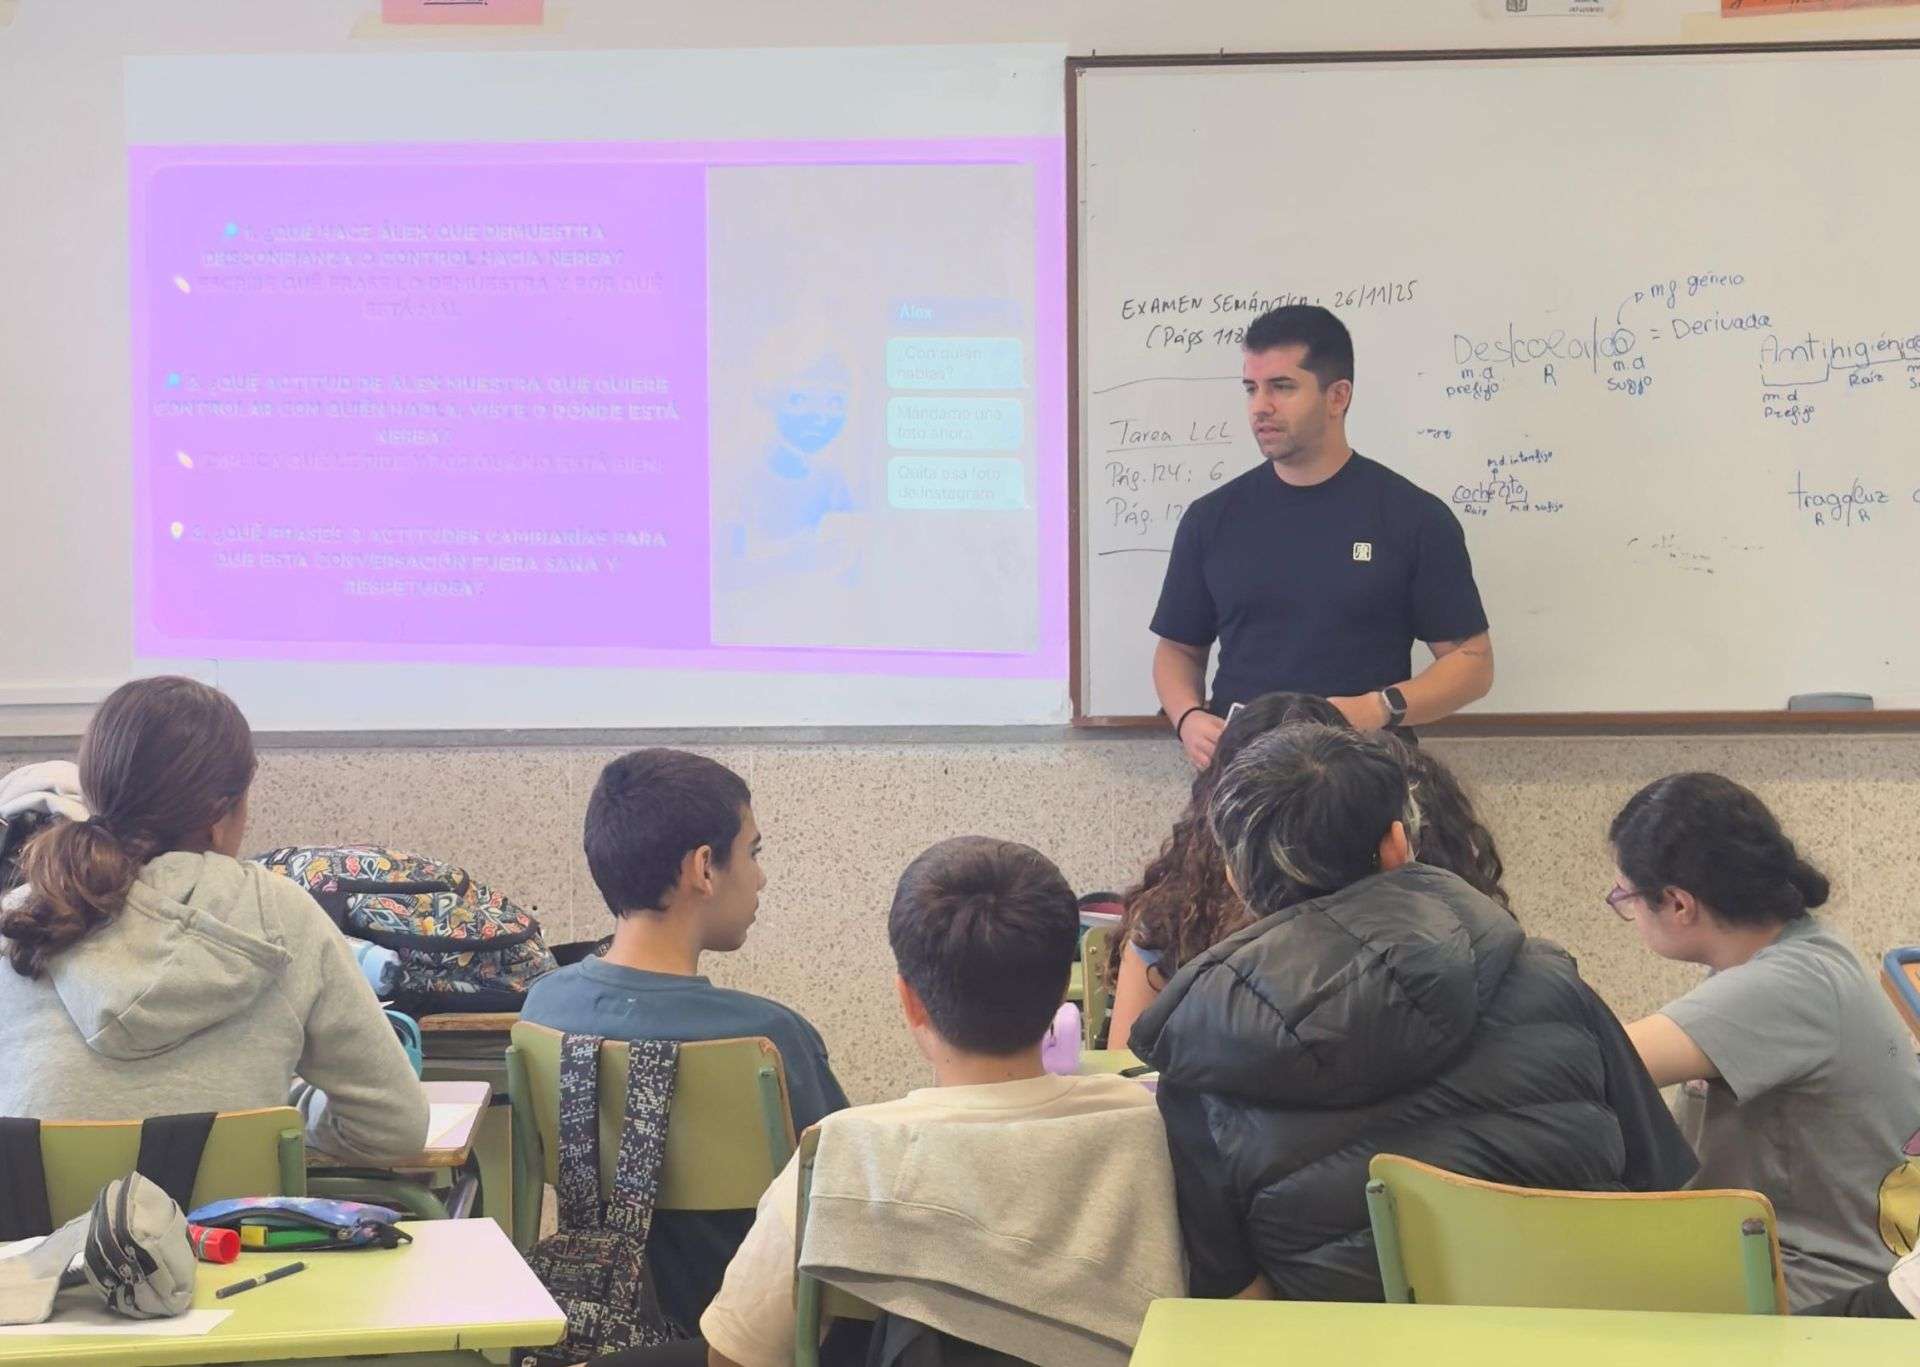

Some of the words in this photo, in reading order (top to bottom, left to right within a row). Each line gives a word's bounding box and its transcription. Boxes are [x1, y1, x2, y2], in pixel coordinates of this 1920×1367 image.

[1121, 295, 1203, 320] EXAMEN
[1333, 280, 1418, 309] 26/11/25
[1671, 310, 1772, 340] Derivada
[1543, 363, 1557, 387] R
[1109, 419, 1174, 445] Tarea
[1209, 460, 1225, 481] 6
